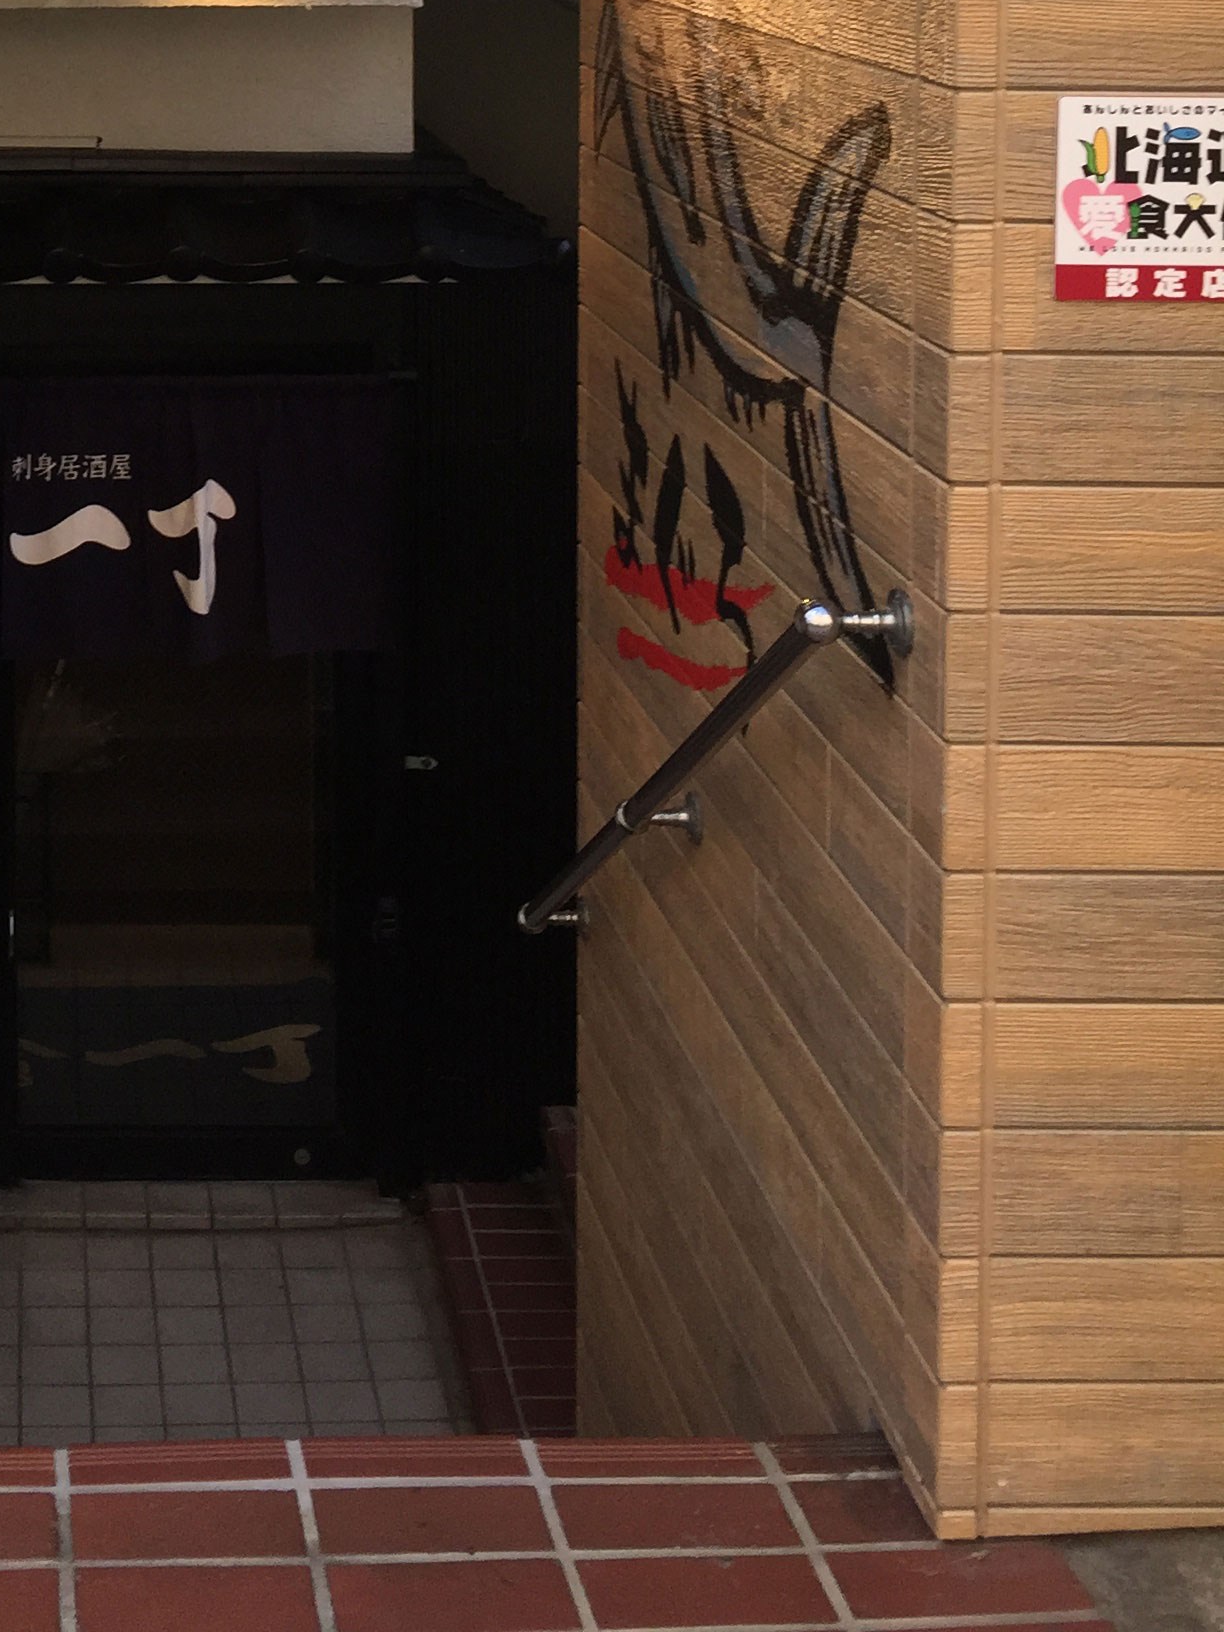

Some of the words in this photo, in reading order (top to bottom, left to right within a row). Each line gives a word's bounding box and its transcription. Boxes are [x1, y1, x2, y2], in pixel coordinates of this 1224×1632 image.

[1078, 193, 1224, 241] 愛食大
[11, 453, 133, 482] 刺身居酒屋
